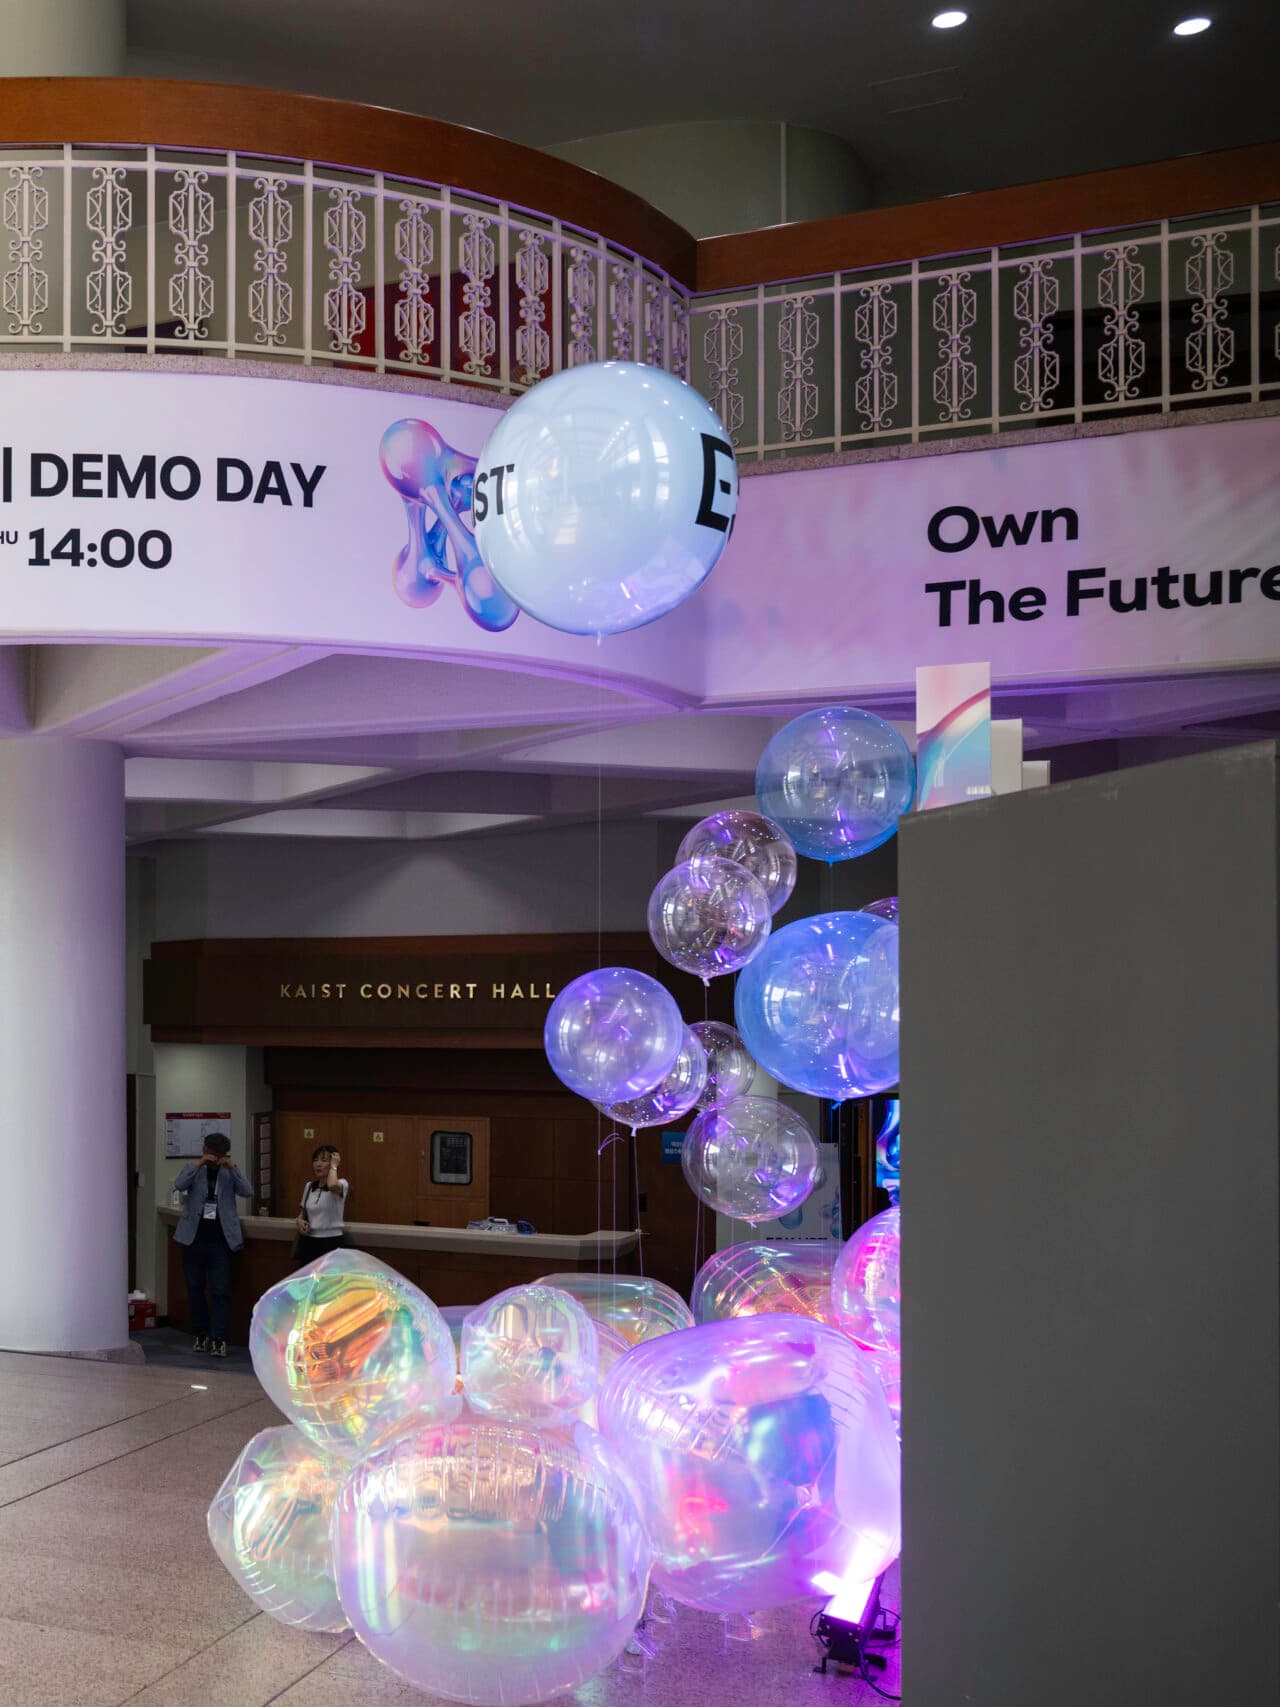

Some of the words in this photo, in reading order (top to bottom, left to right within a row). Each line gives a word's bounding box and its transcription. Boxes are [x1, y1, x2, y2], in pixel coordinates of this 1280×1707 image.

[30, 453, 201, 501] DEMO
[216, 457, 327, 508] DAY
[28, 527, 173, 570] 14:00
[927, 505, 1079, 554] Own
[925, 578, 1047, 627] The
[1066, 564, 1280, 617] Future
[280, 983, 347, 999] KAIST
[359, 983, 478, 999] CONCERT
[492, 982, 557, 999] HALL
